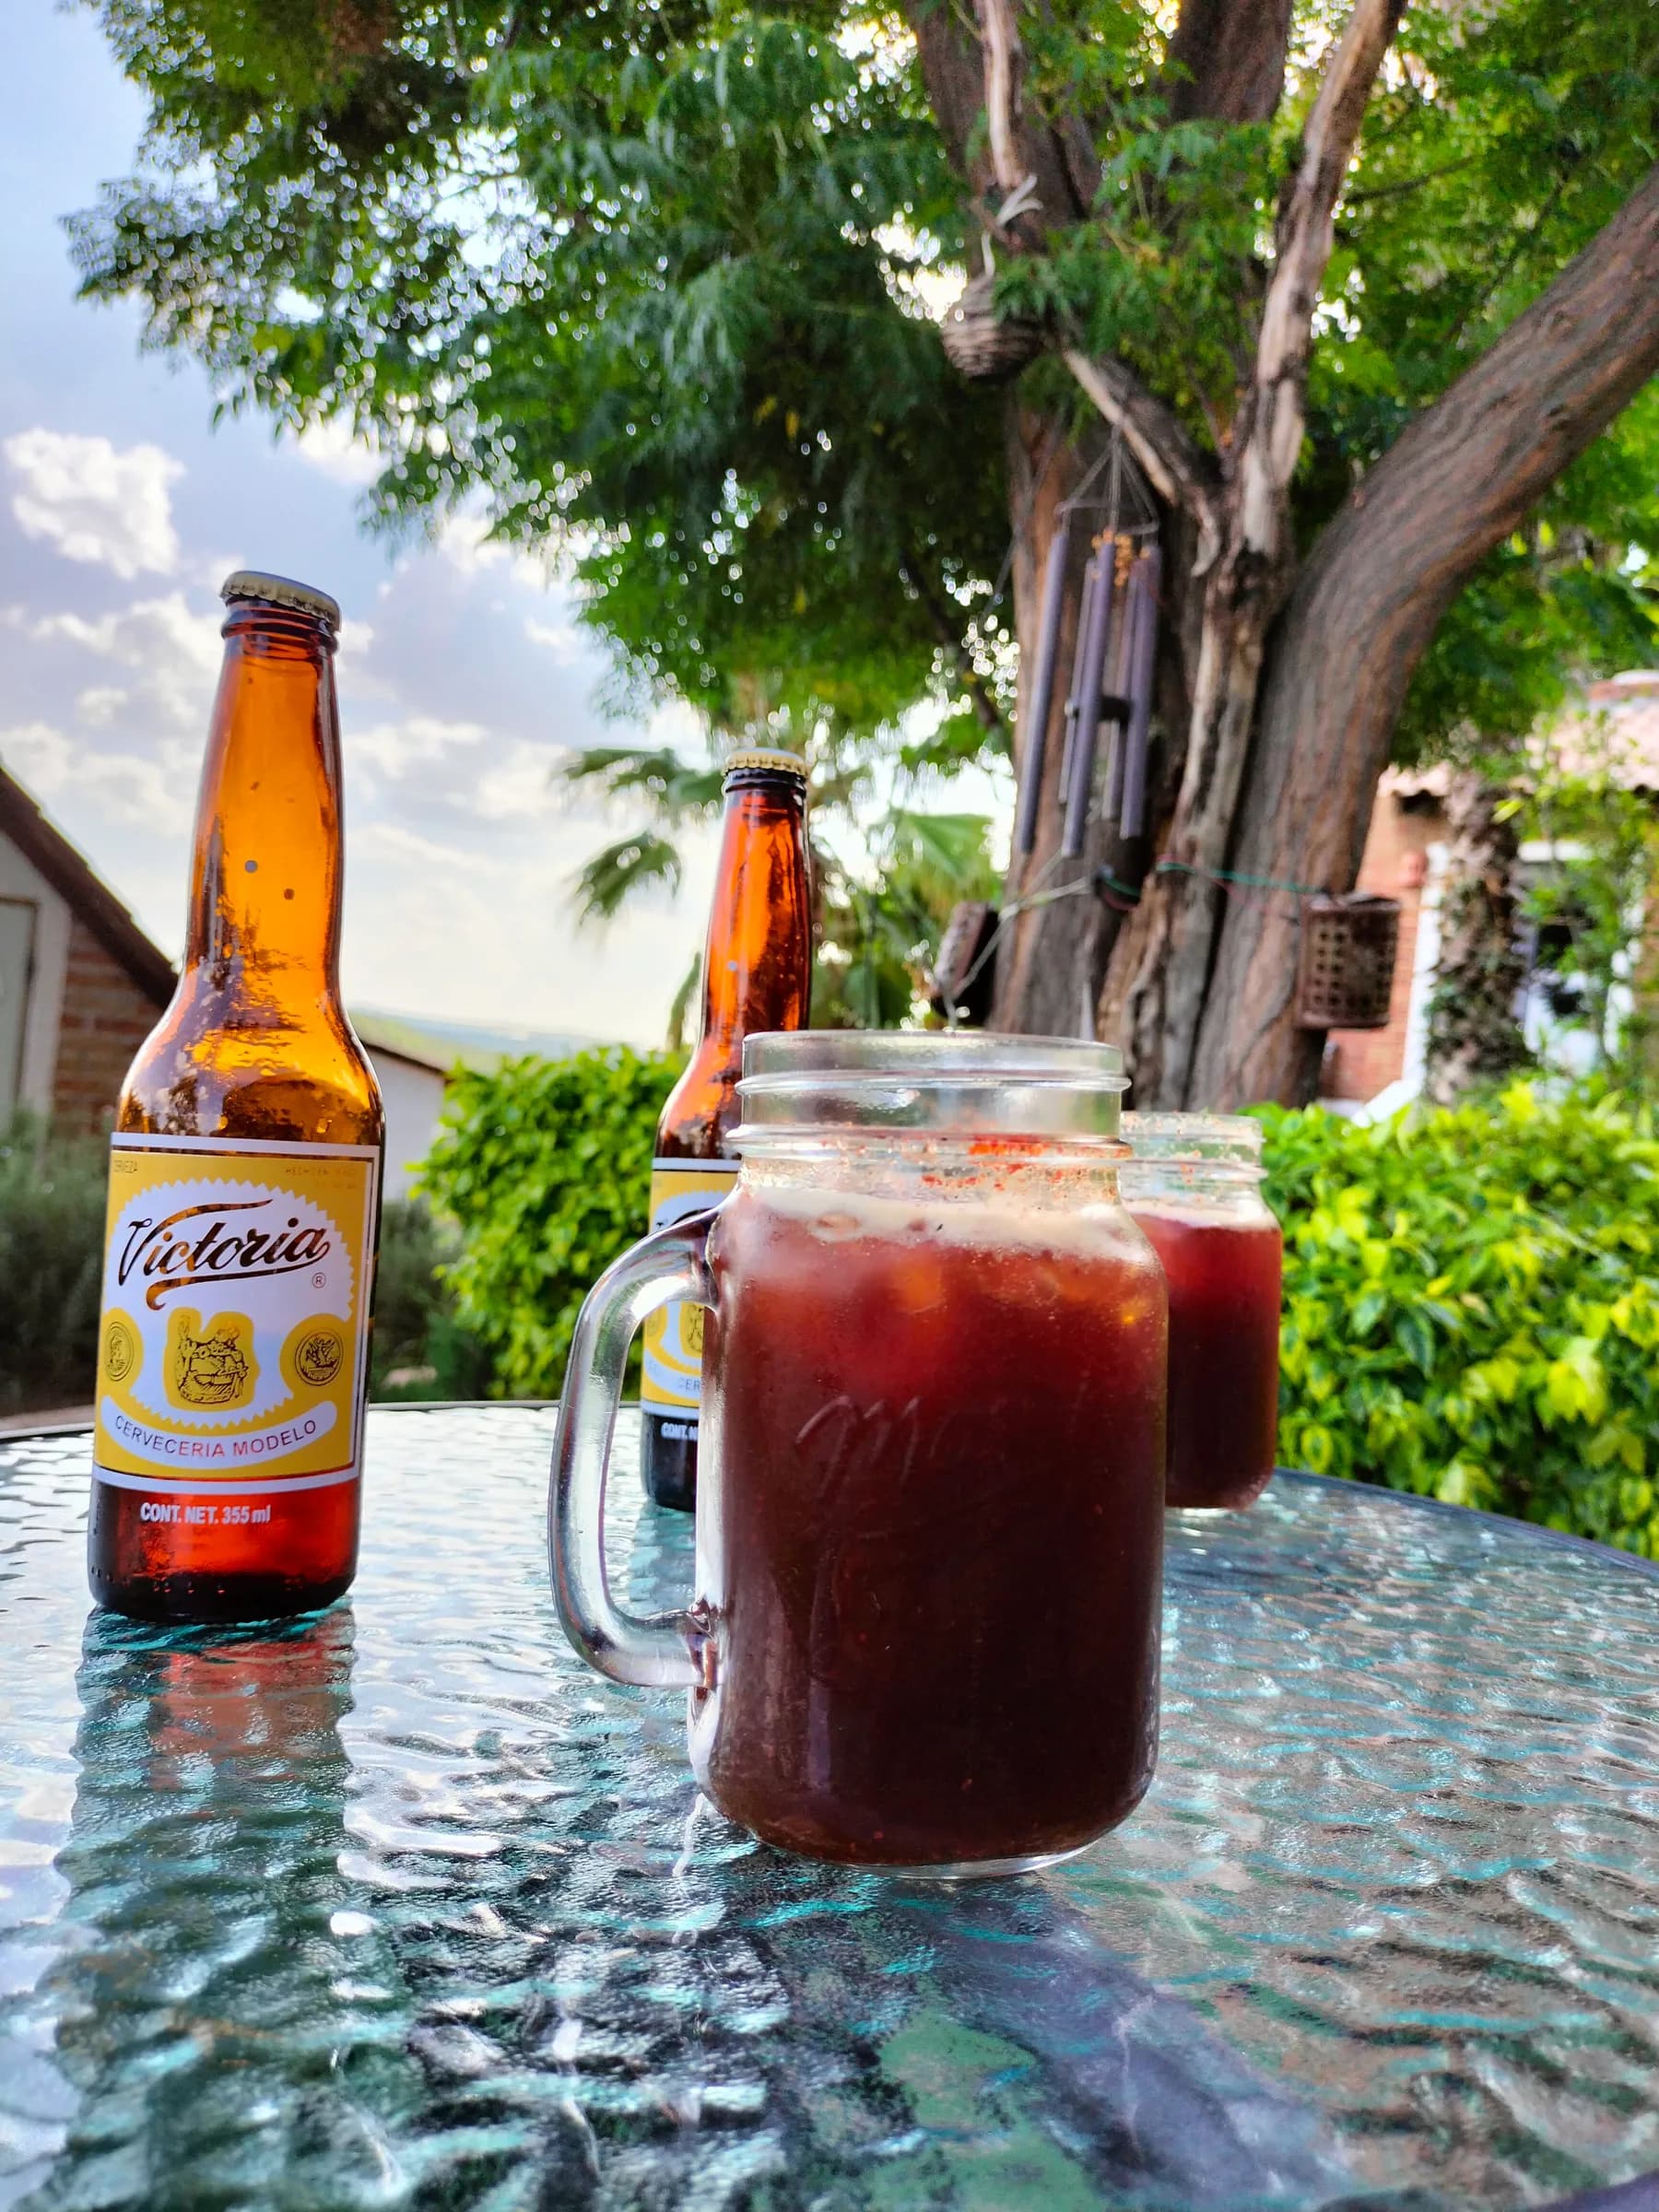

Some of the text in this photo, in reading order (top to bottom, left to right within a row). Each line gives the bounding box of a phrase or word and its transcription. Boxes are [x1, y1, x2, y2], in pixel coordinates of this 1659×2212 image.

[119, 1199, 331, 1310] Victoria
[114, 1415, 317, 1457] CERVECERIA MODELO
[140, 1501, 271, 1524] CONT. NET. 355 ml
